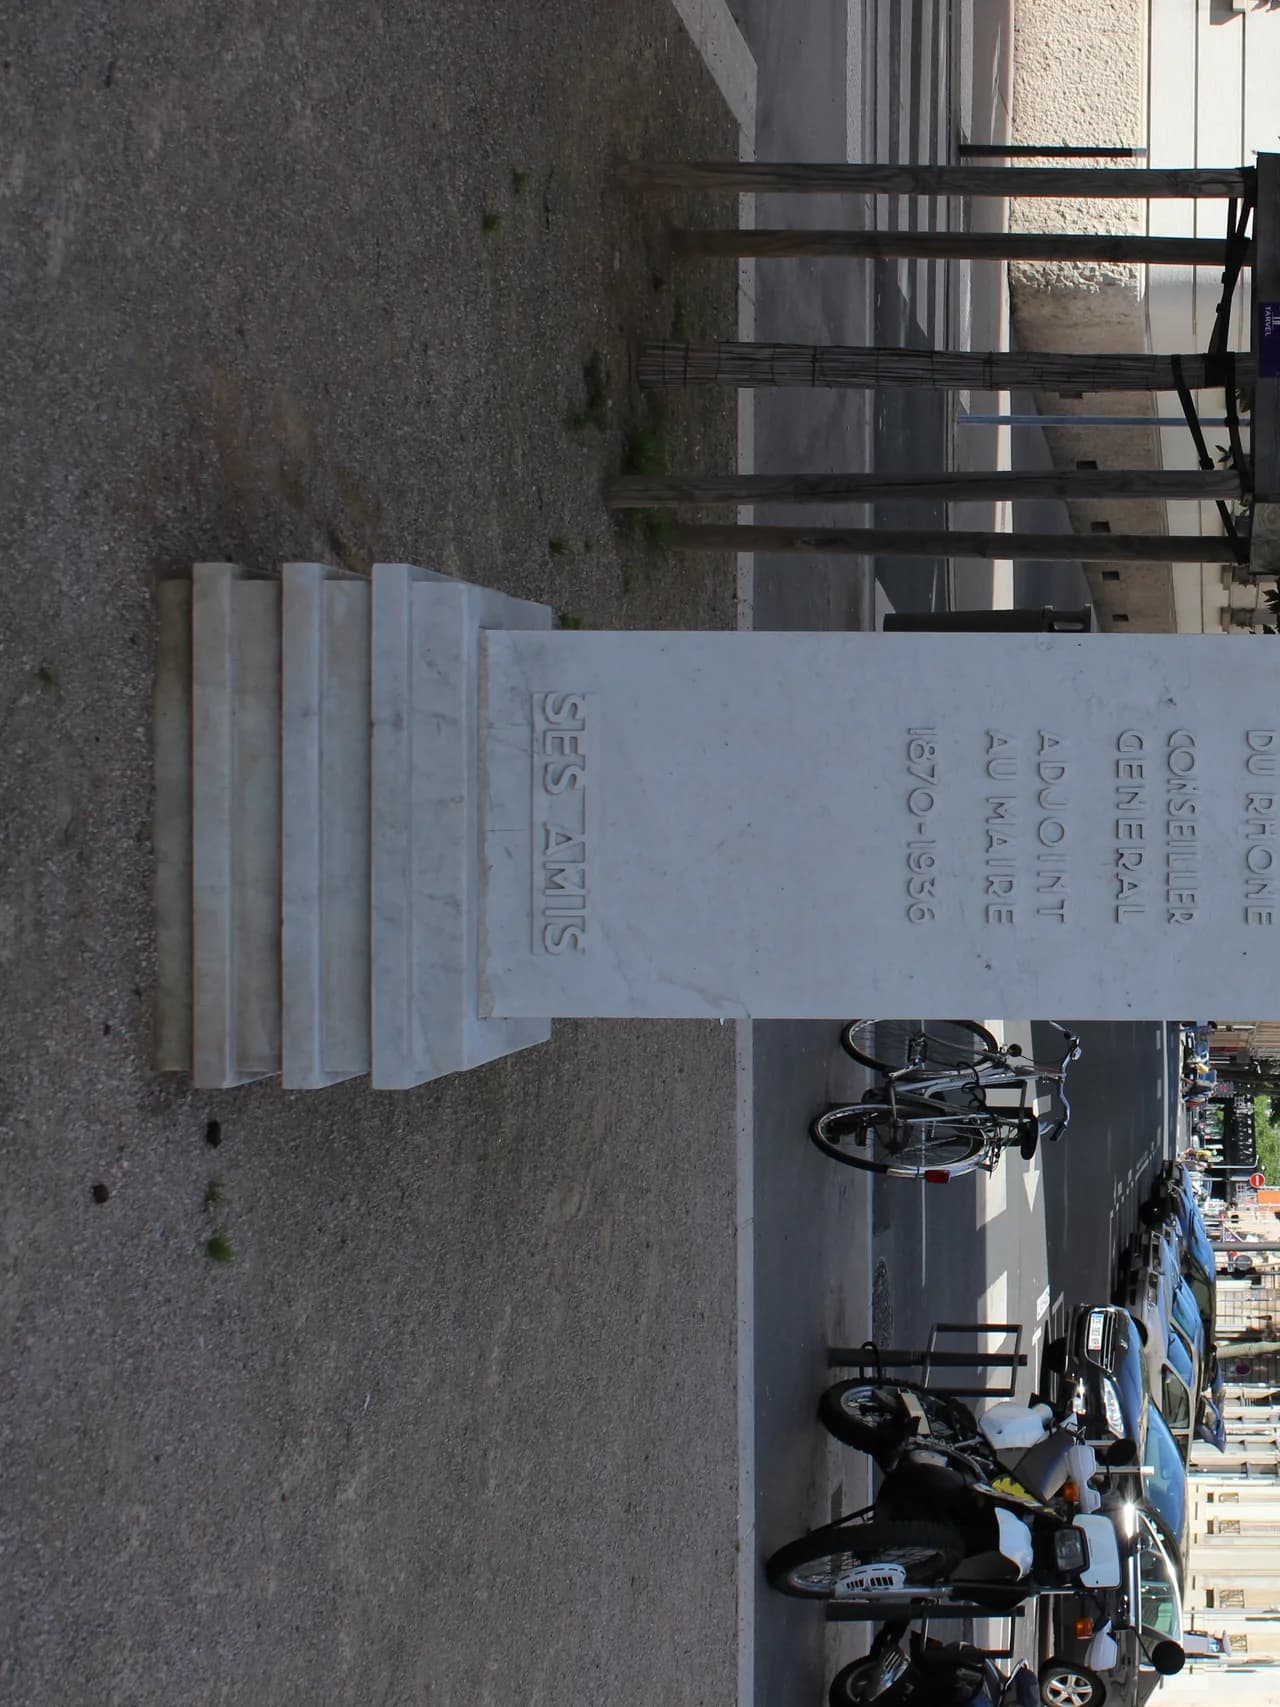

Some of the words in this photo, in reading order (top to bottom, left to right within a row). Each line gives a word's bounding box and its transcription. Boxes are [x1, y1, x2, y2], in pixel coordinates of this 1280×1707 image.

[1264, 305, 1272, 337] TARVEL
[543, 692, 586, 796] SES
[985, 729, 1016, 781] AU
[1246, 729, 1277, 777] DU
[542, 821, 587, 955] AMIS
[907, 727, 938, 926] 1870-1936
[985, 795, 1016, 926] MAIRE
[1037, 729, 1067, 924] ADJOINT
[1115, 729, 1148, 926] GENERAL
[1166, 729, 1199, 926] CONSEILLER
[1245, 792, 1278, 926] RHONE
